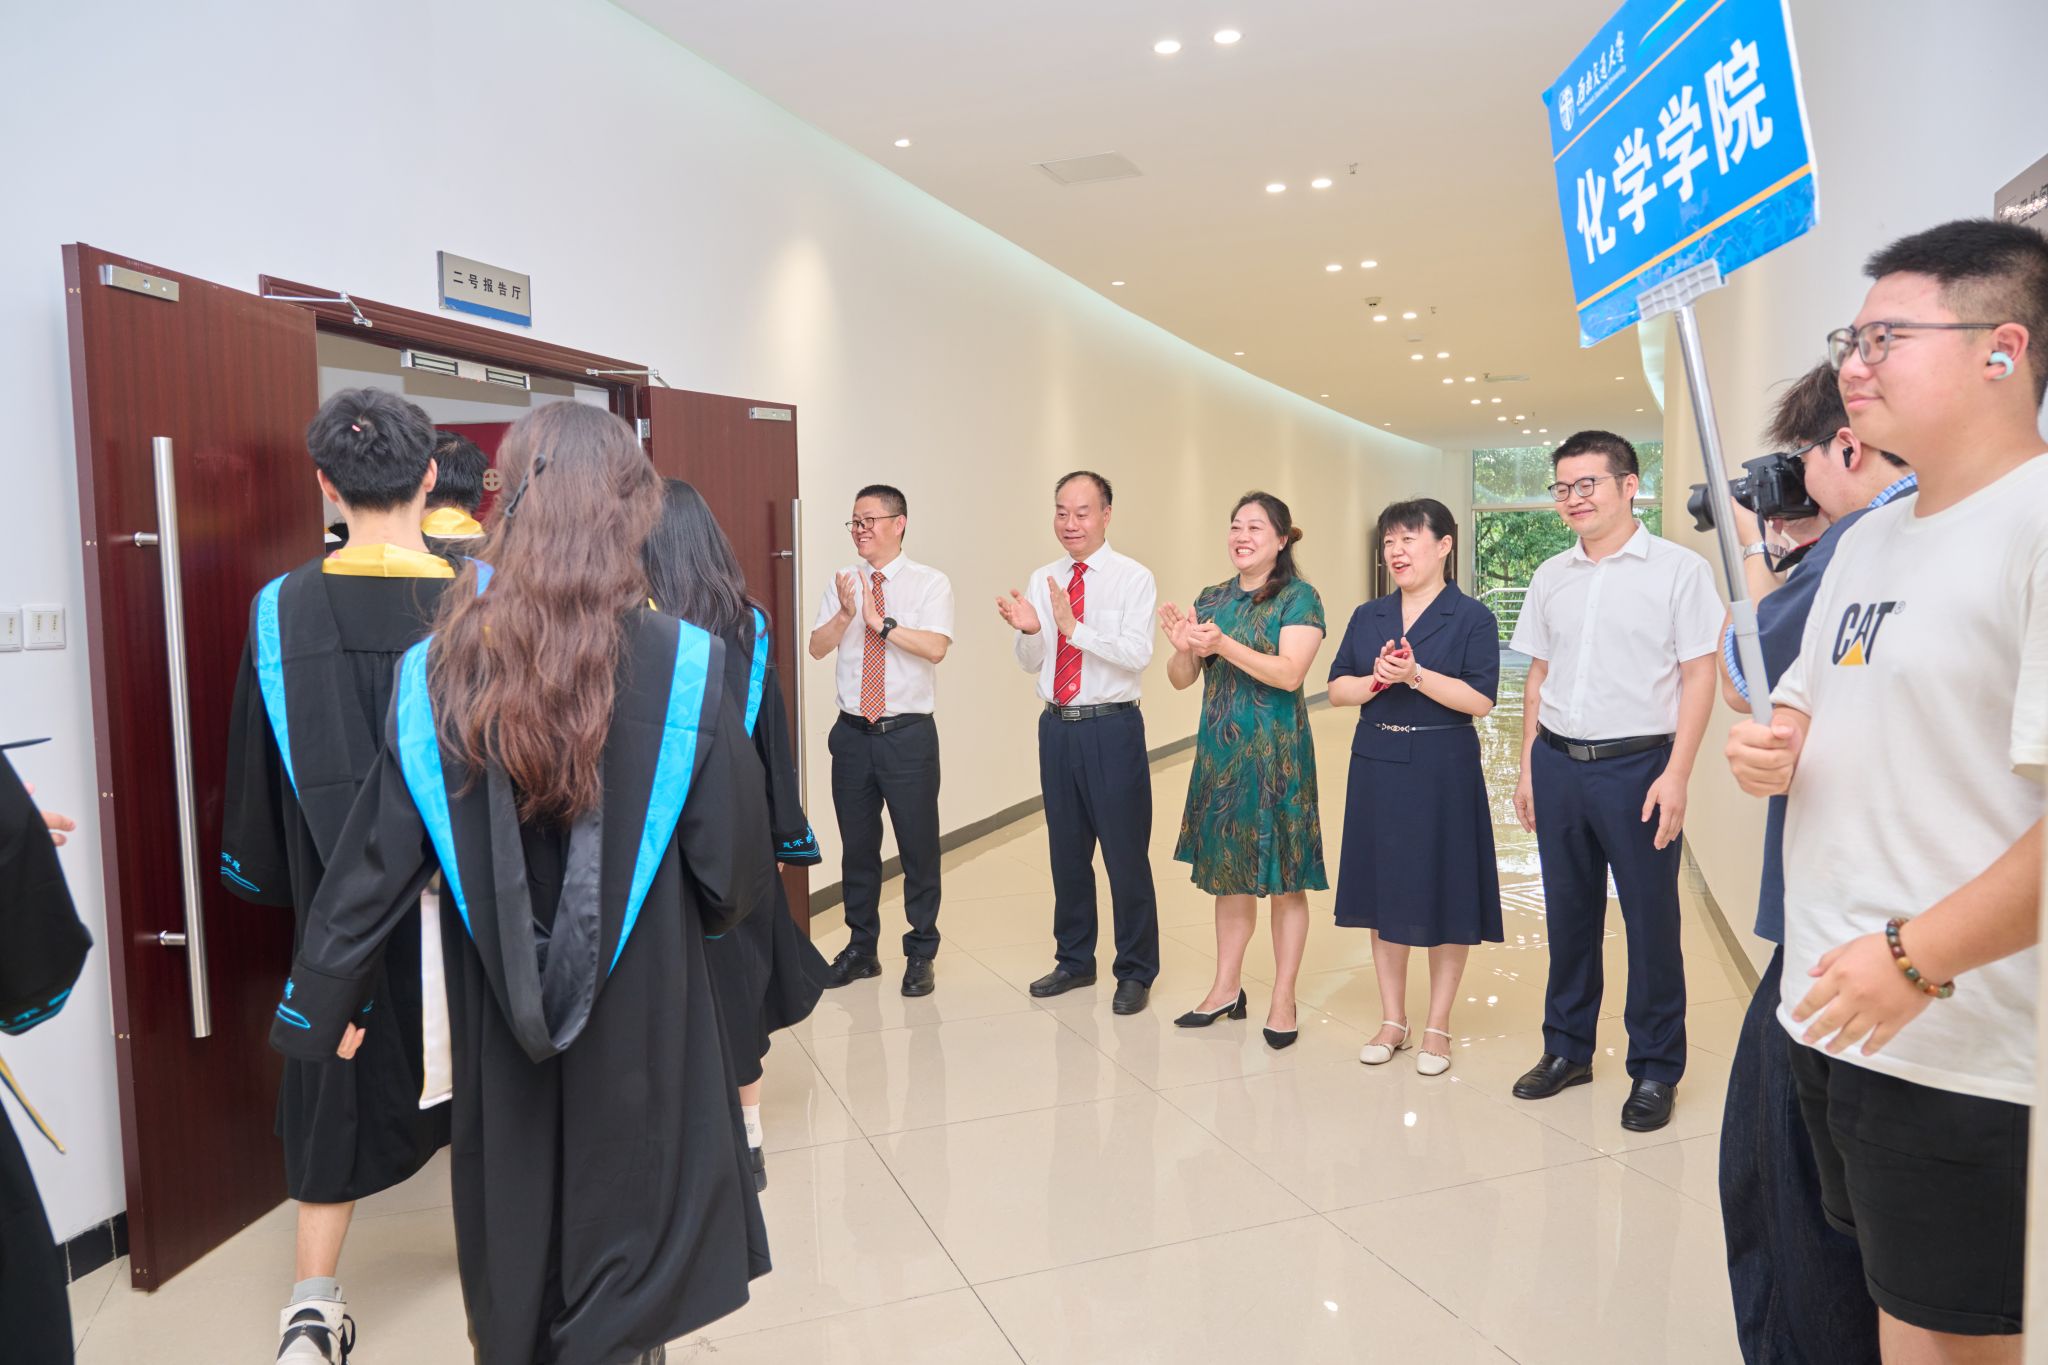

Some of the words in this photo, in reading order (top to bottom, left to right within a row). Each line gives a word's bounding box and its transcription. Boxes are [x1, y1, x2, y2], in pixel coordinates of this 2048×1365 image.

[1577, 38, 1773, 264] 化学学院
[453, 270, 521, 300] 二号报告厅
